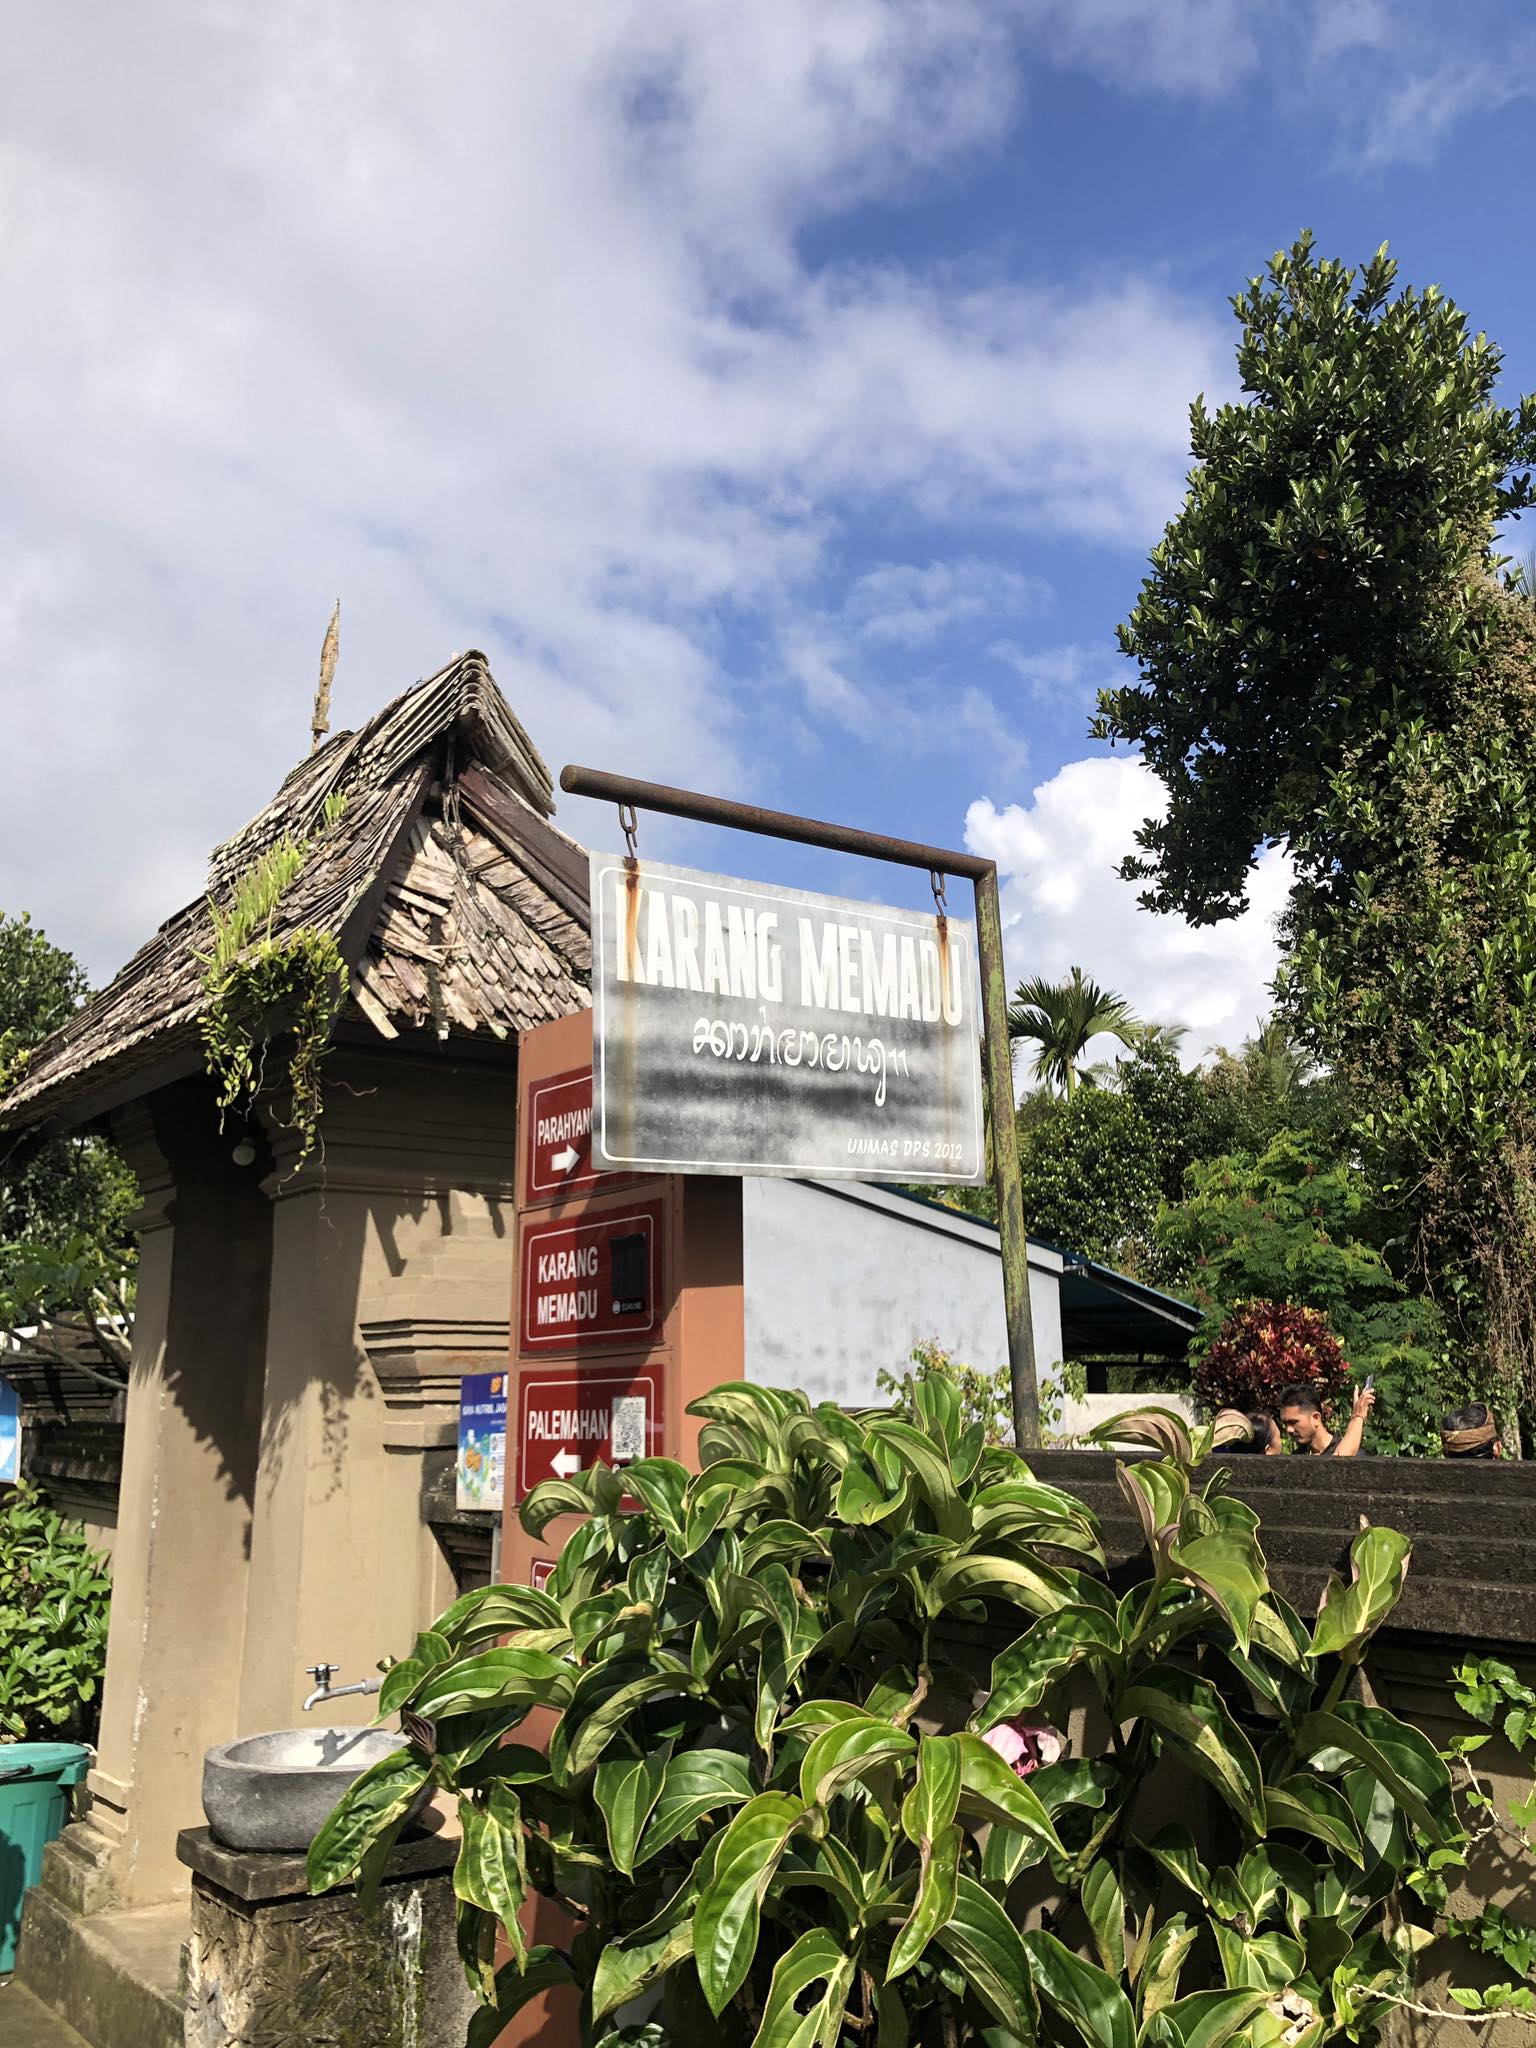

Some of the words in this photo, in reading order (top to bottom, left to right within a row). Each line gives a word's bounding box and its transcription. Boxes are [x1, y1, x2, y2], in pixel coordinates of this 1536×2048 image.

[615, 883, 783, 1003] KARANG
[798, 917, 963, 1027] MEMADU
[537, 1107, 593, 1147] PARAHYAN
[847, 1137, 898, 1157] UNMAS
[903, 1139, 931, 1158] DPS
[934, 1141, 963, 1160] 2012
[538, 1246, 598, 1284] KARANG
[537, 1288, 598, 1325] MEMADU
[528, 1408, 609, 1440] PALEMAHAN
